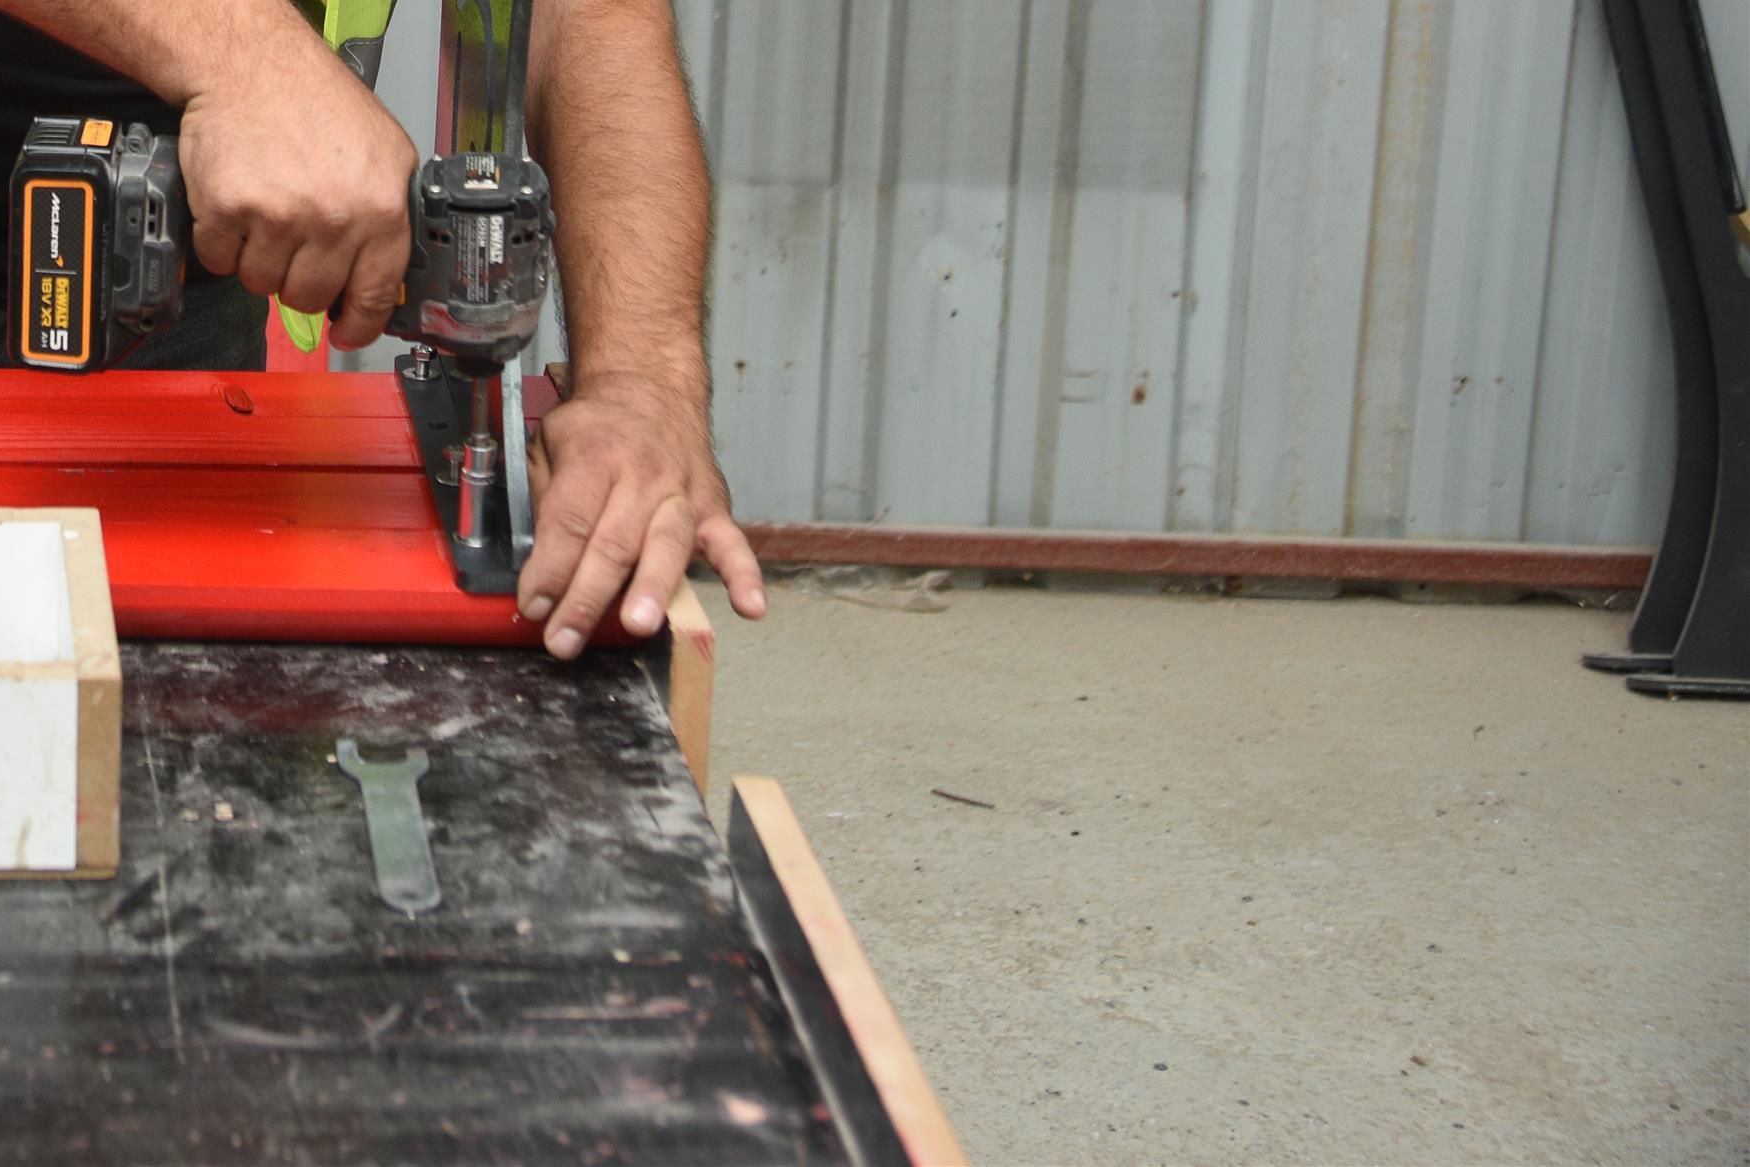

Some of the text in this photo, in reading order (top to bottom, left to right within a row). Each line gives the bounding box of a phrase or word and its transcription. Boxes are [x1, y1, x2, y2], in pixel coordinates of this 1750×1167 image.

[51, 192, 61, 259] McLaren
[41, 277, 52, 327] 18V XR
[55, 277, 69, 329] DEWALT
[50, 329, 68, 351] 5
